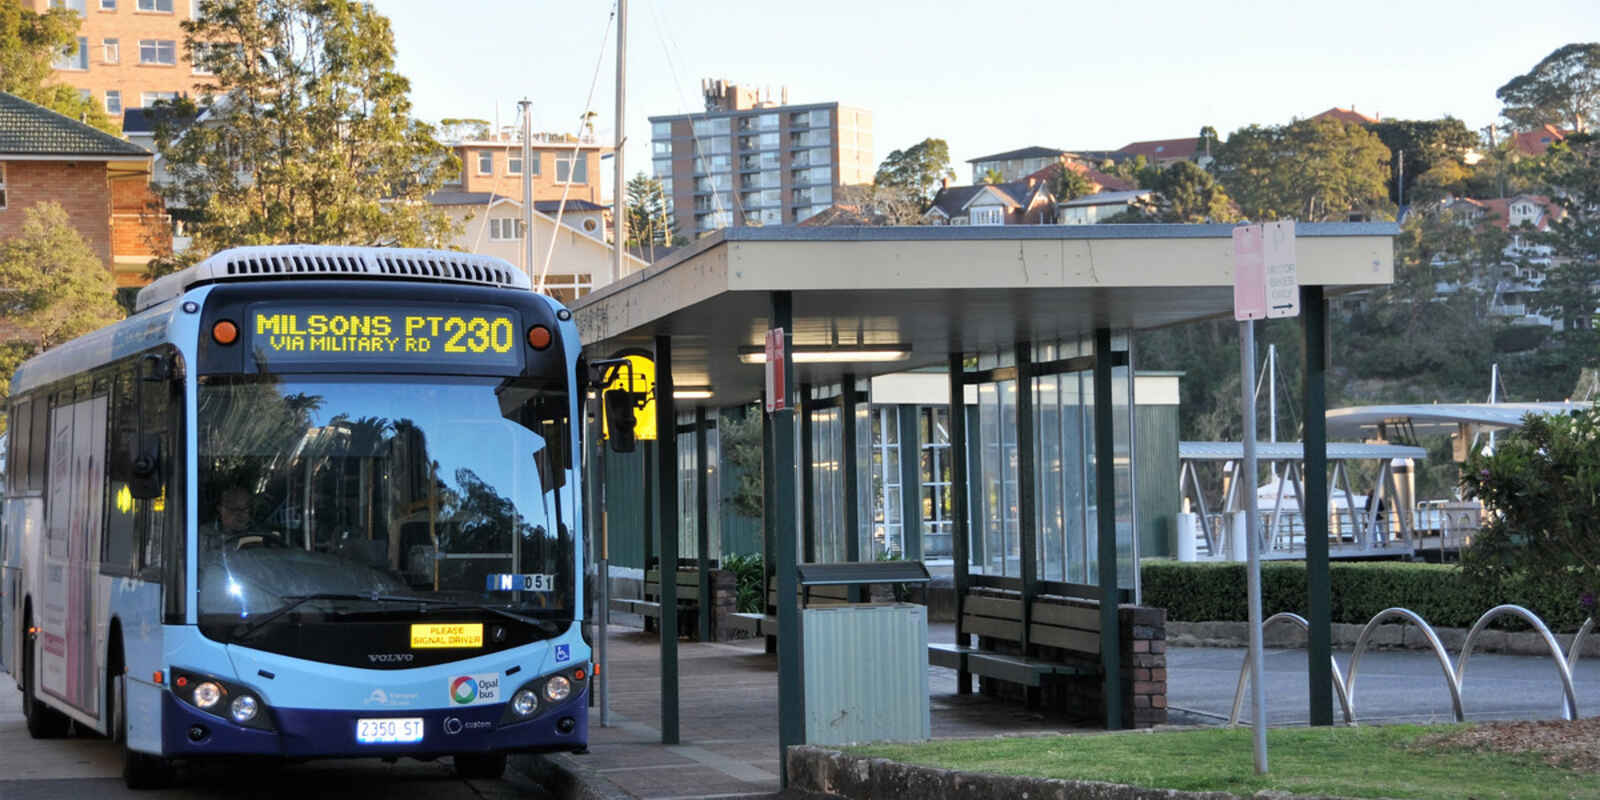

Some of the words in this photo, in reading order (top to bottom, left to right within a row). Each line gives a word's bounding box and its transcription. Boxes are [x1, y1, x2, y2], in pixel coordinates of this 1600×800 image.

[256, 314, 392, 336] MILSONS
[405, 316, 443, 337] PT
[444, 317, 513, 353] 230
[269, 335, 305, 351] VIA
[310, 336, 399, 352] MILITARY
[405, 337, 431, 353] RD
[523, 575, 552, 591] 051
[429, 626, 465, 635] PLEASE
[413, 635, 446, 645] SIGNAL
[448, 635, 481, 645] DRIVER
[367, 653, 415, 662] VOLVO
[478, 678, 499, 691] Opal
[479, 688, 494, 699] bus
[361, 721, 396, 737] 2350
[403, 720, 421, 736] ST
